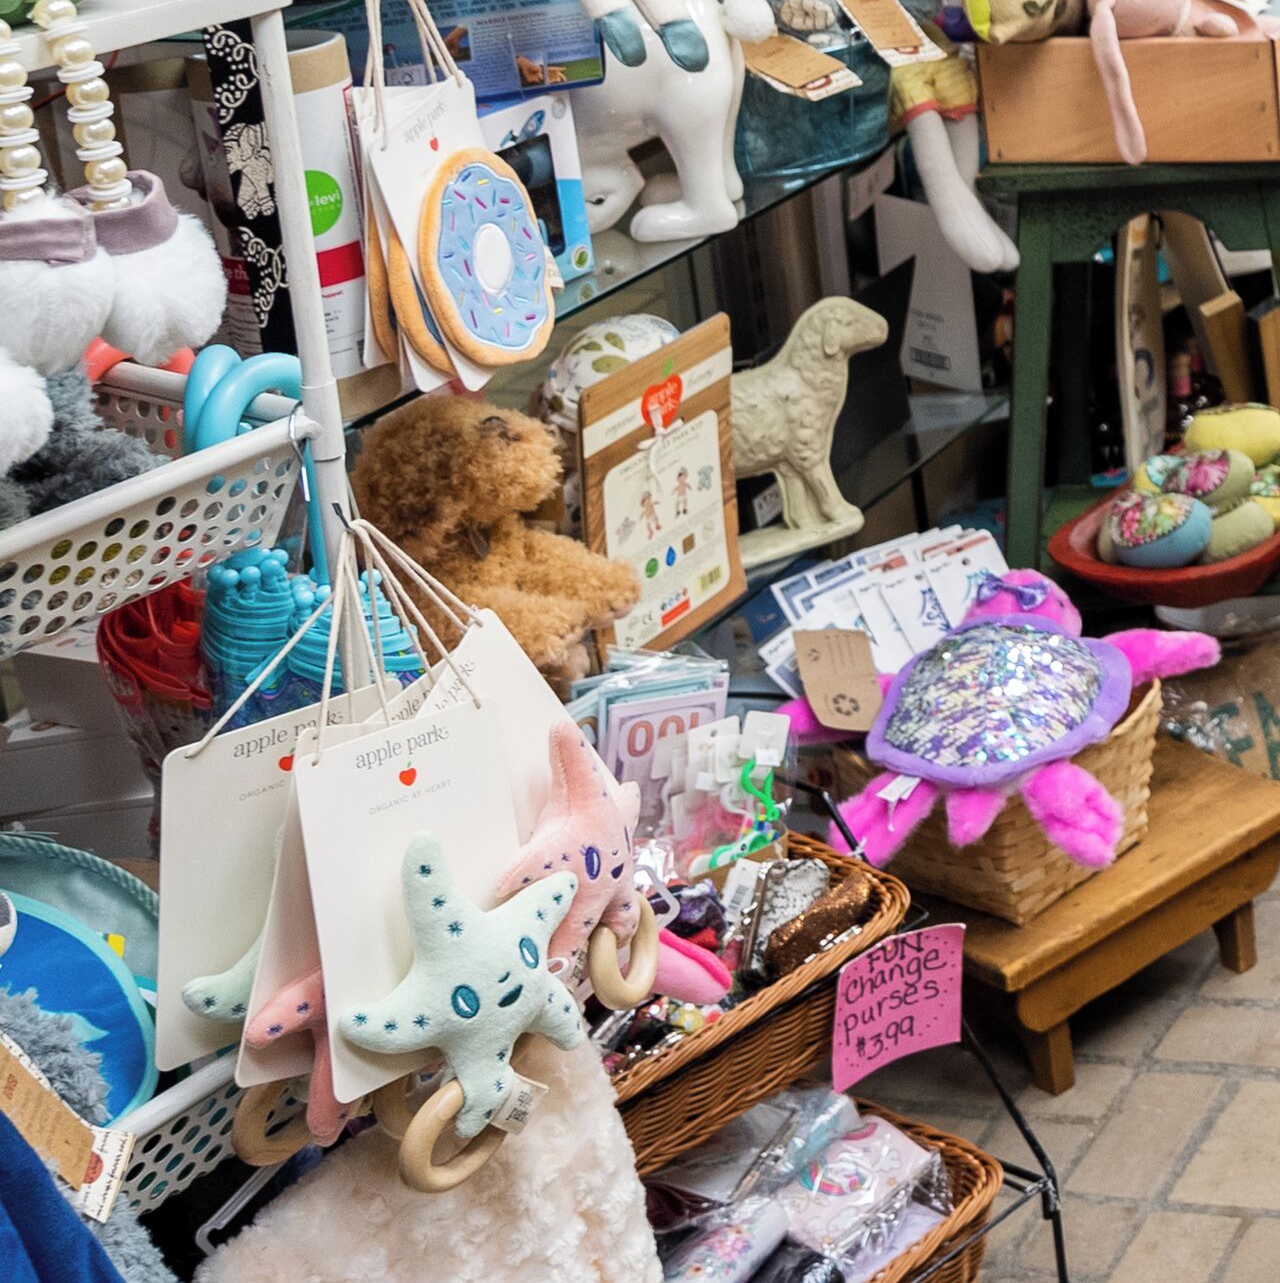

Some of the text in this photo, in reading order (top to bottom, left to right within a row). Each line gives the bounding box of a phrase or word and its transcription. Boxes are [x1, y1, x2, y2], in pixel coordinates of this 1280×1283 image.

[233, 727, 288, 759] apple
[355, 723, 450, 770] apple park
[238, 778, 287, 802] ORGANIC
[368, 778, 453, 816] ORGANIC AT HEART
[866, 931, 925, 974] FUN
[844, 948, 948, 1005] Change
[842, 979, 940, 1047] purses
